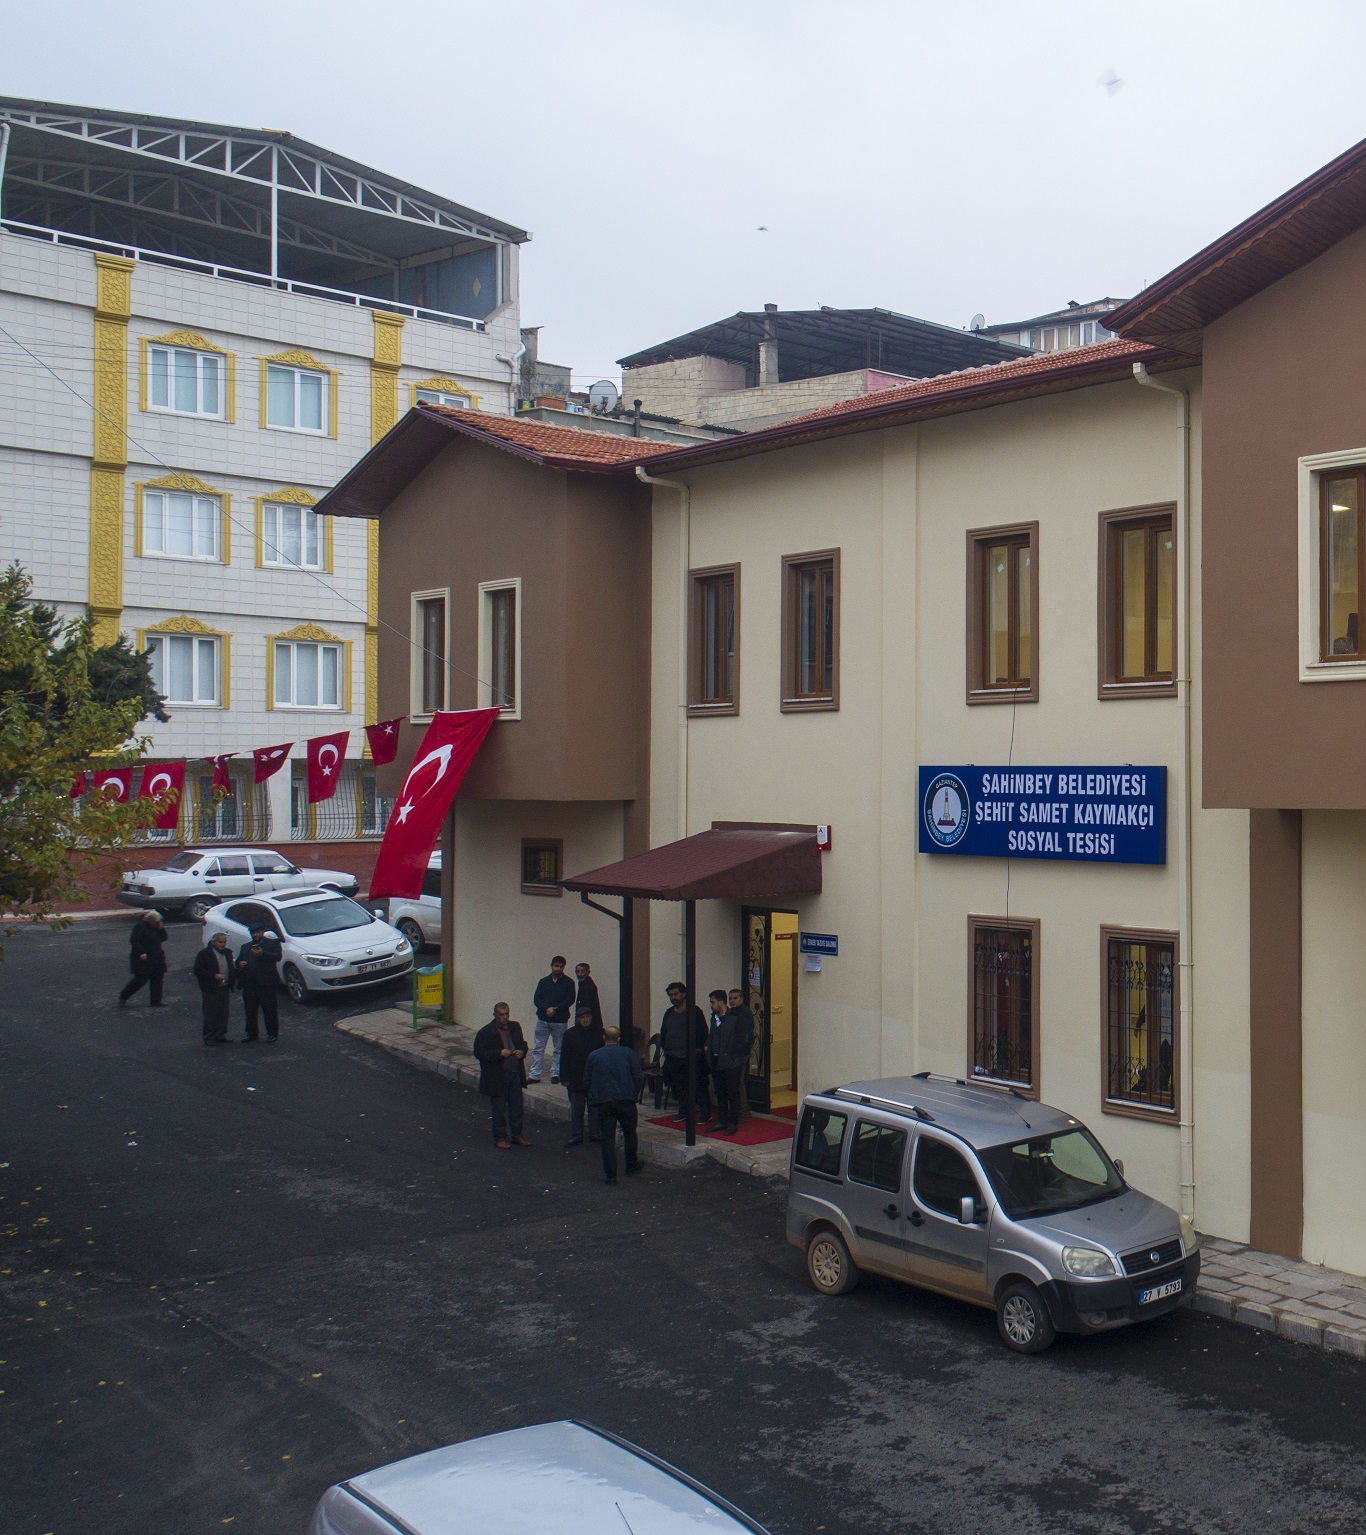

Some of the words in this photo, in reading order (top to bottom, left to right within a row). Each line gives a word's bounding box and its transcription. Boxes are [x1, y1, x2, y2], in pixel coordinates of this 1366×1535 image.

[982, 773, 1053, 797] ŞAHİNBEY
[1058, 774, 1146, 796] BELEDİYESİ
[975, 801, 1015, 825] ŞEHİT
[1019, 802, 1069, 824] SAMET
[1074, 803, 1154, 830] KAYMAKÇI
[1008, 830, 1062, 852] SOSYAL
[1066, 832, 1115, 855] TESİSİ
[1143, 1291, 1153, 1302] 27
[1165, 1280, 1181, 1294] 5793
